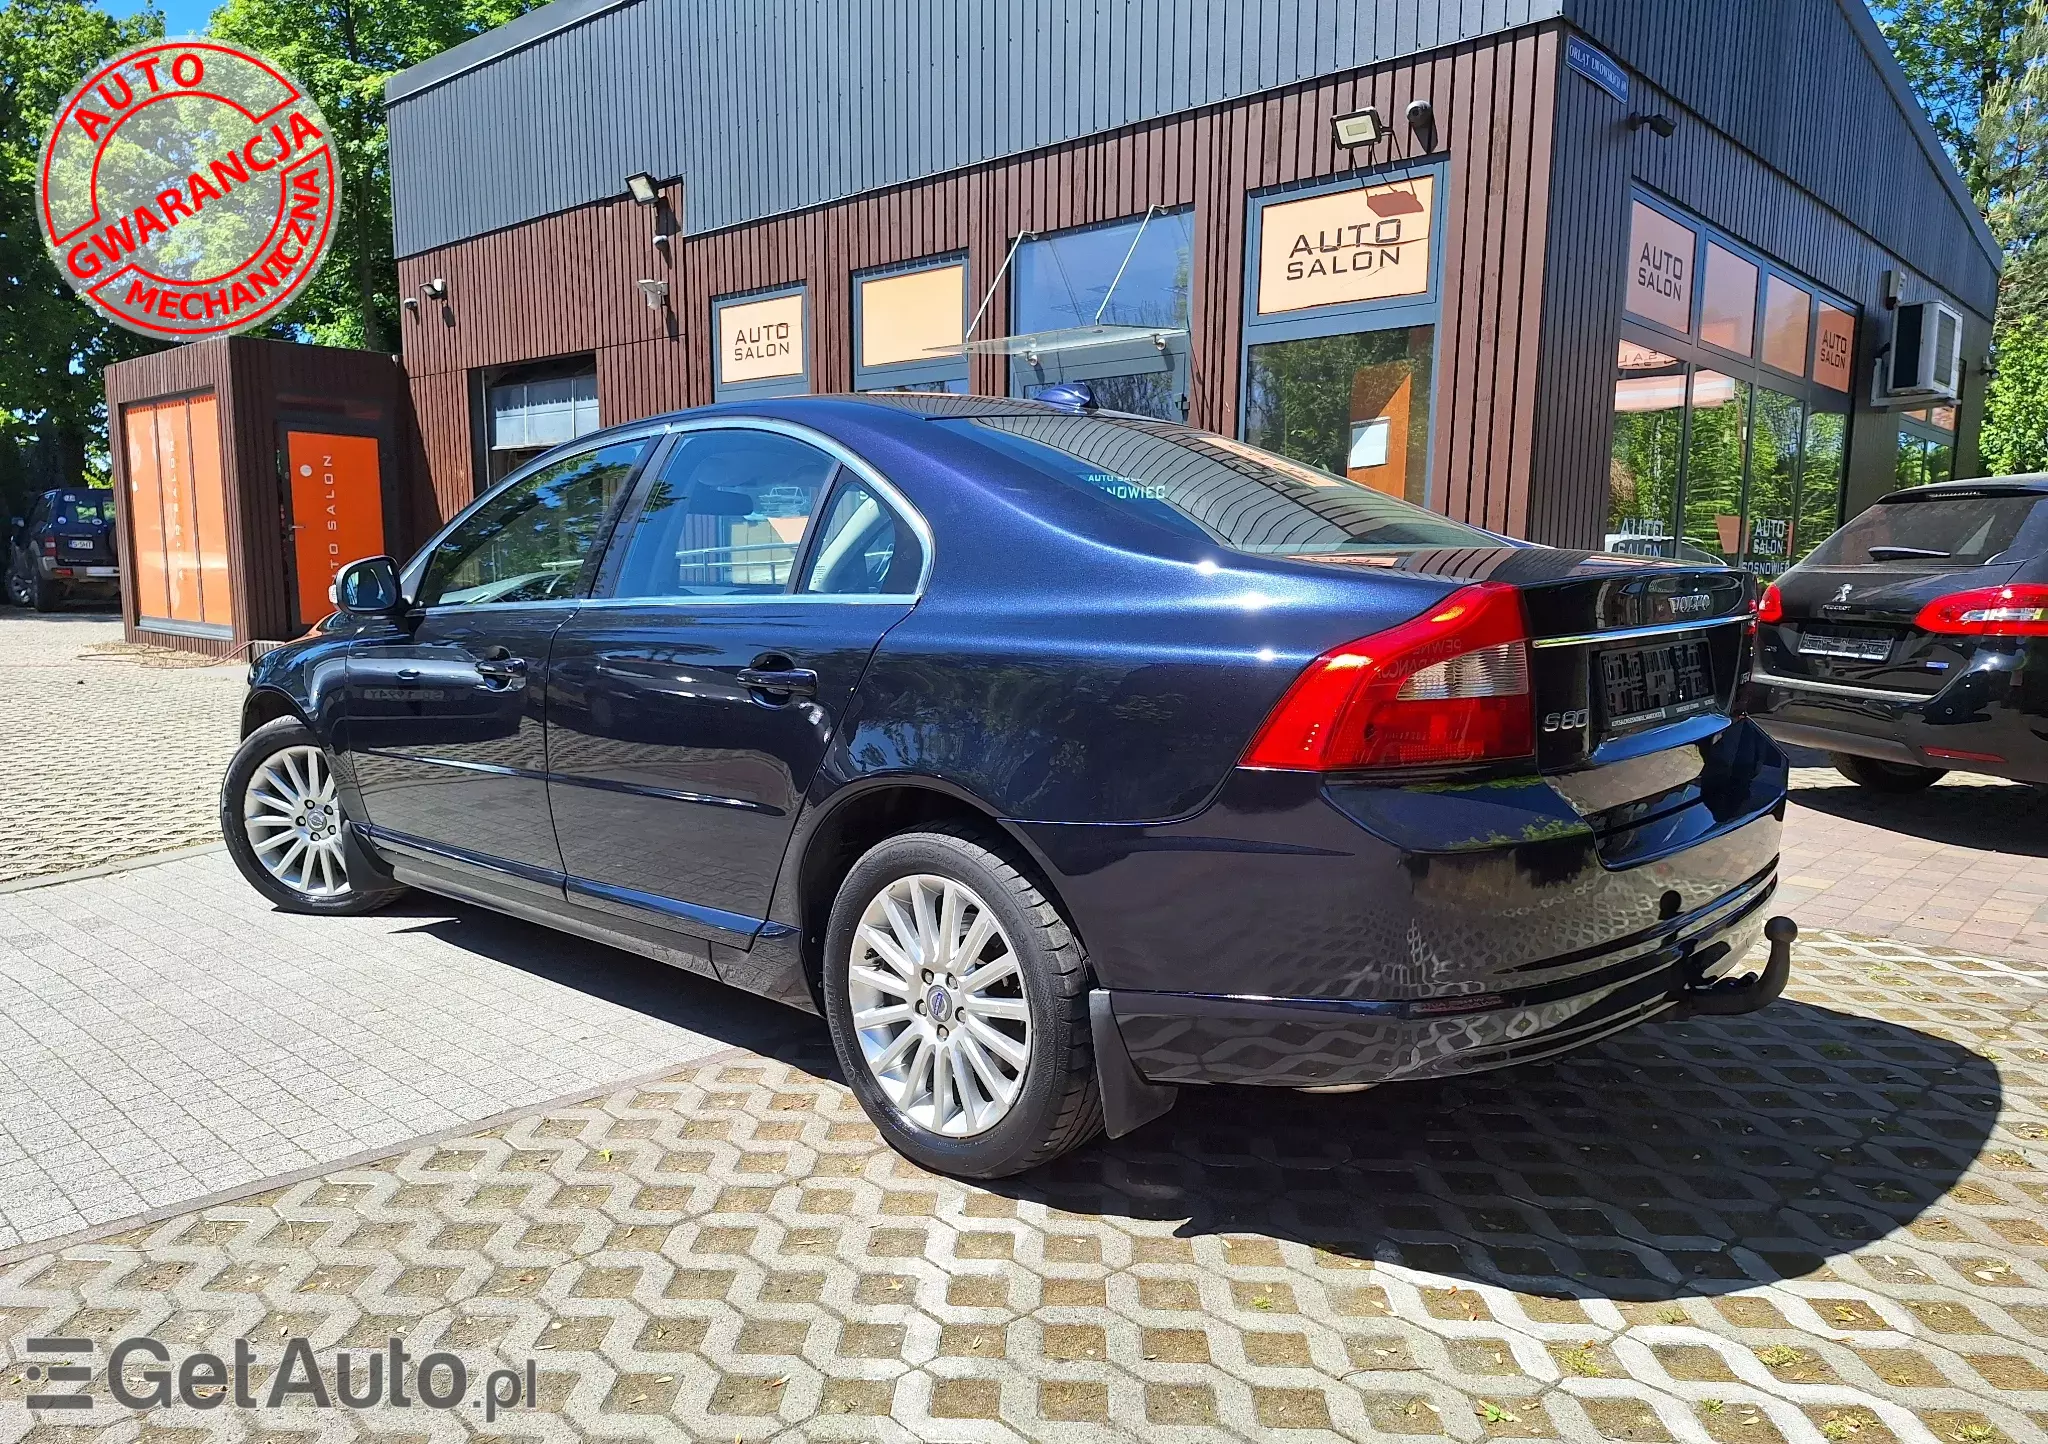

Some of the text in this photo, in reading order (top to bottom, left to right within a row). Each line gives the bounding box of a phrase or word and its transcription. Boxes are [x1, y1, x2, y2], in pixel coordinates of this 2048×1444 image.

[1289, 218, 1402, 259] AUTO
[1286, 246, 1401, 281] SALON
[1640, 241, 1684, 280] AUTO
[1637, 266, 1683, 302] SALON
[734, 322, 789, 346] AUTO
[1821, 329, 1848, 355] AUTO
[734, 341, 790, 362] SALON
[1820, 349, 1846, 370] SALON
[1087, 474, 1114, 482] AUTO
[322, 455, 337, 531] SALON
[1100, 485, 1166, 500] NOWIEC
[1620, 518, 1664, 541] AUTO
[1754, 518, 1785, 538] AUTO
[1753, 538, 1783, 555] SALON
[1543, 708, 1589, 732] S80
